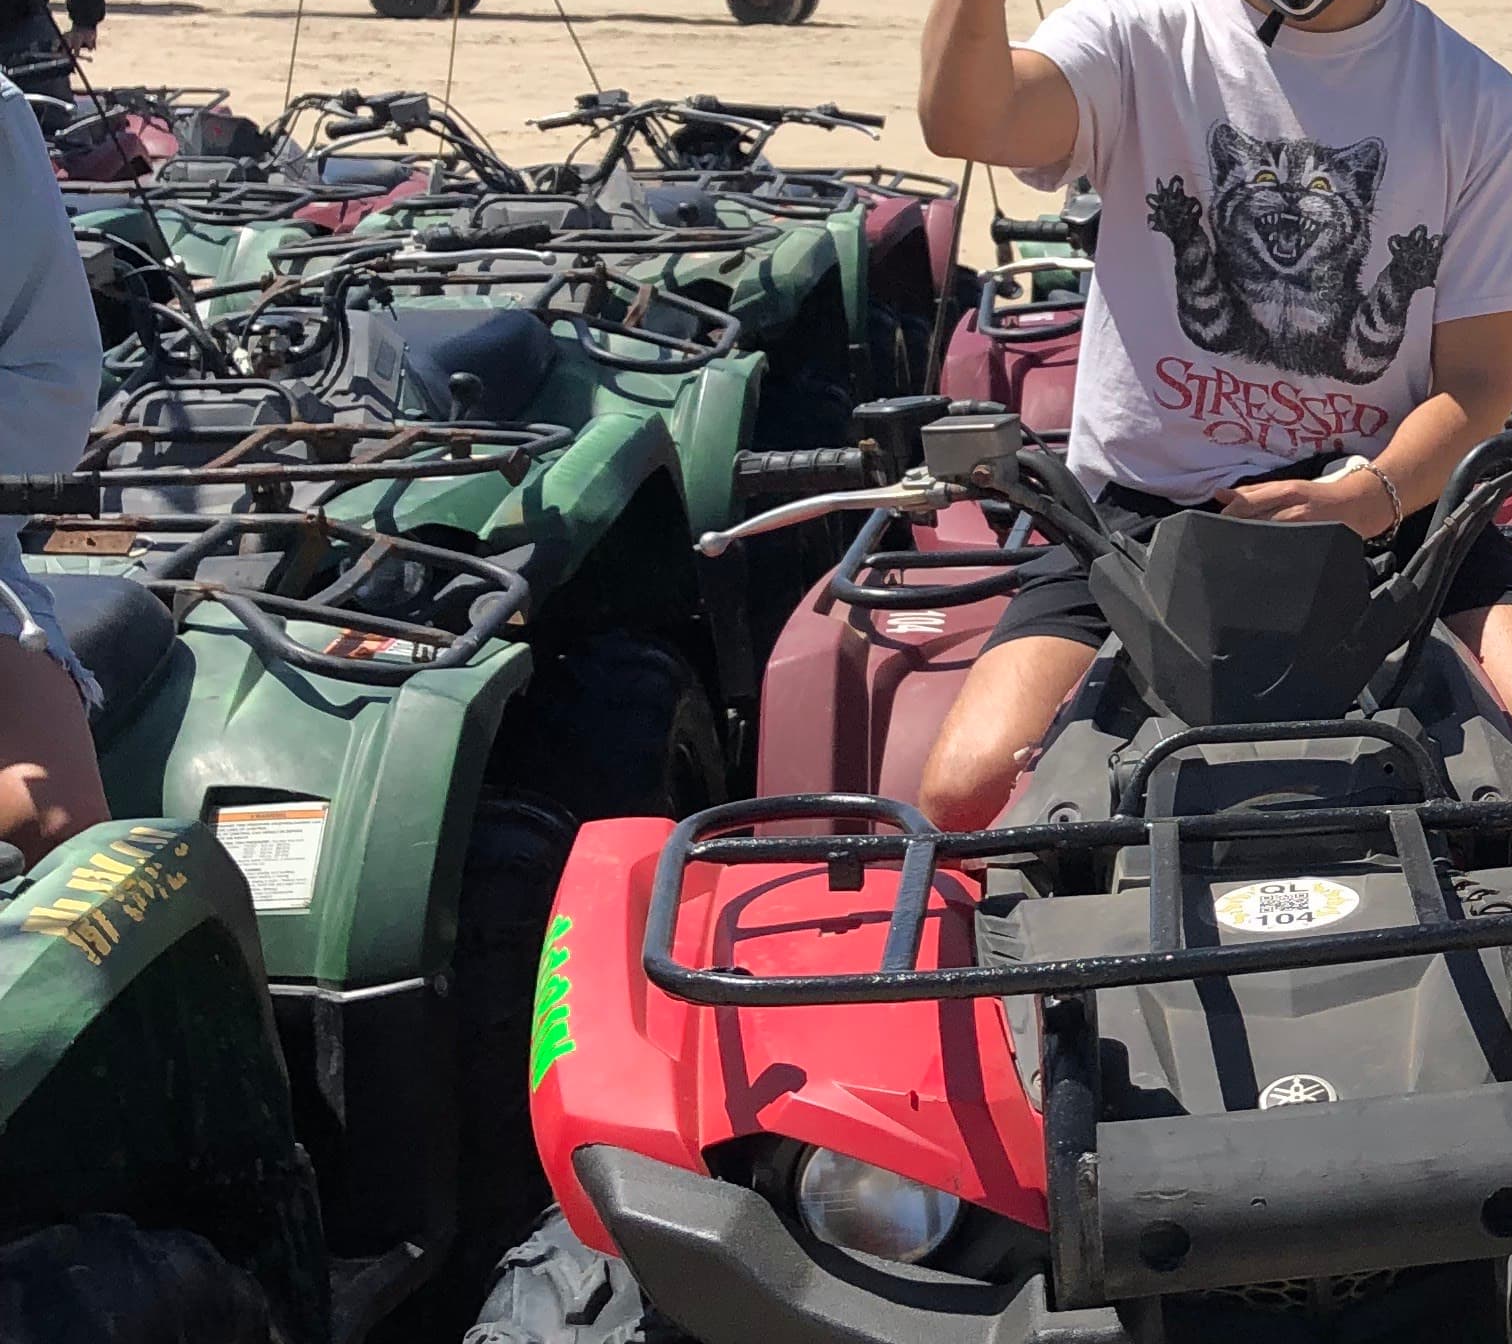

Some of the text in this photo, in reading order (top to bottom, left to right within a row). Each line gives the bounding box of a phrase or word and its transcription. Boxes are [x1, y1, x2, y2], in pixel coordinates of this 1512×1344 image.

[1153, 356, 1389, 438] STRESSED
[1260, 884, 1309, 894] QL
[1257, 912, 1315, 926] 104
